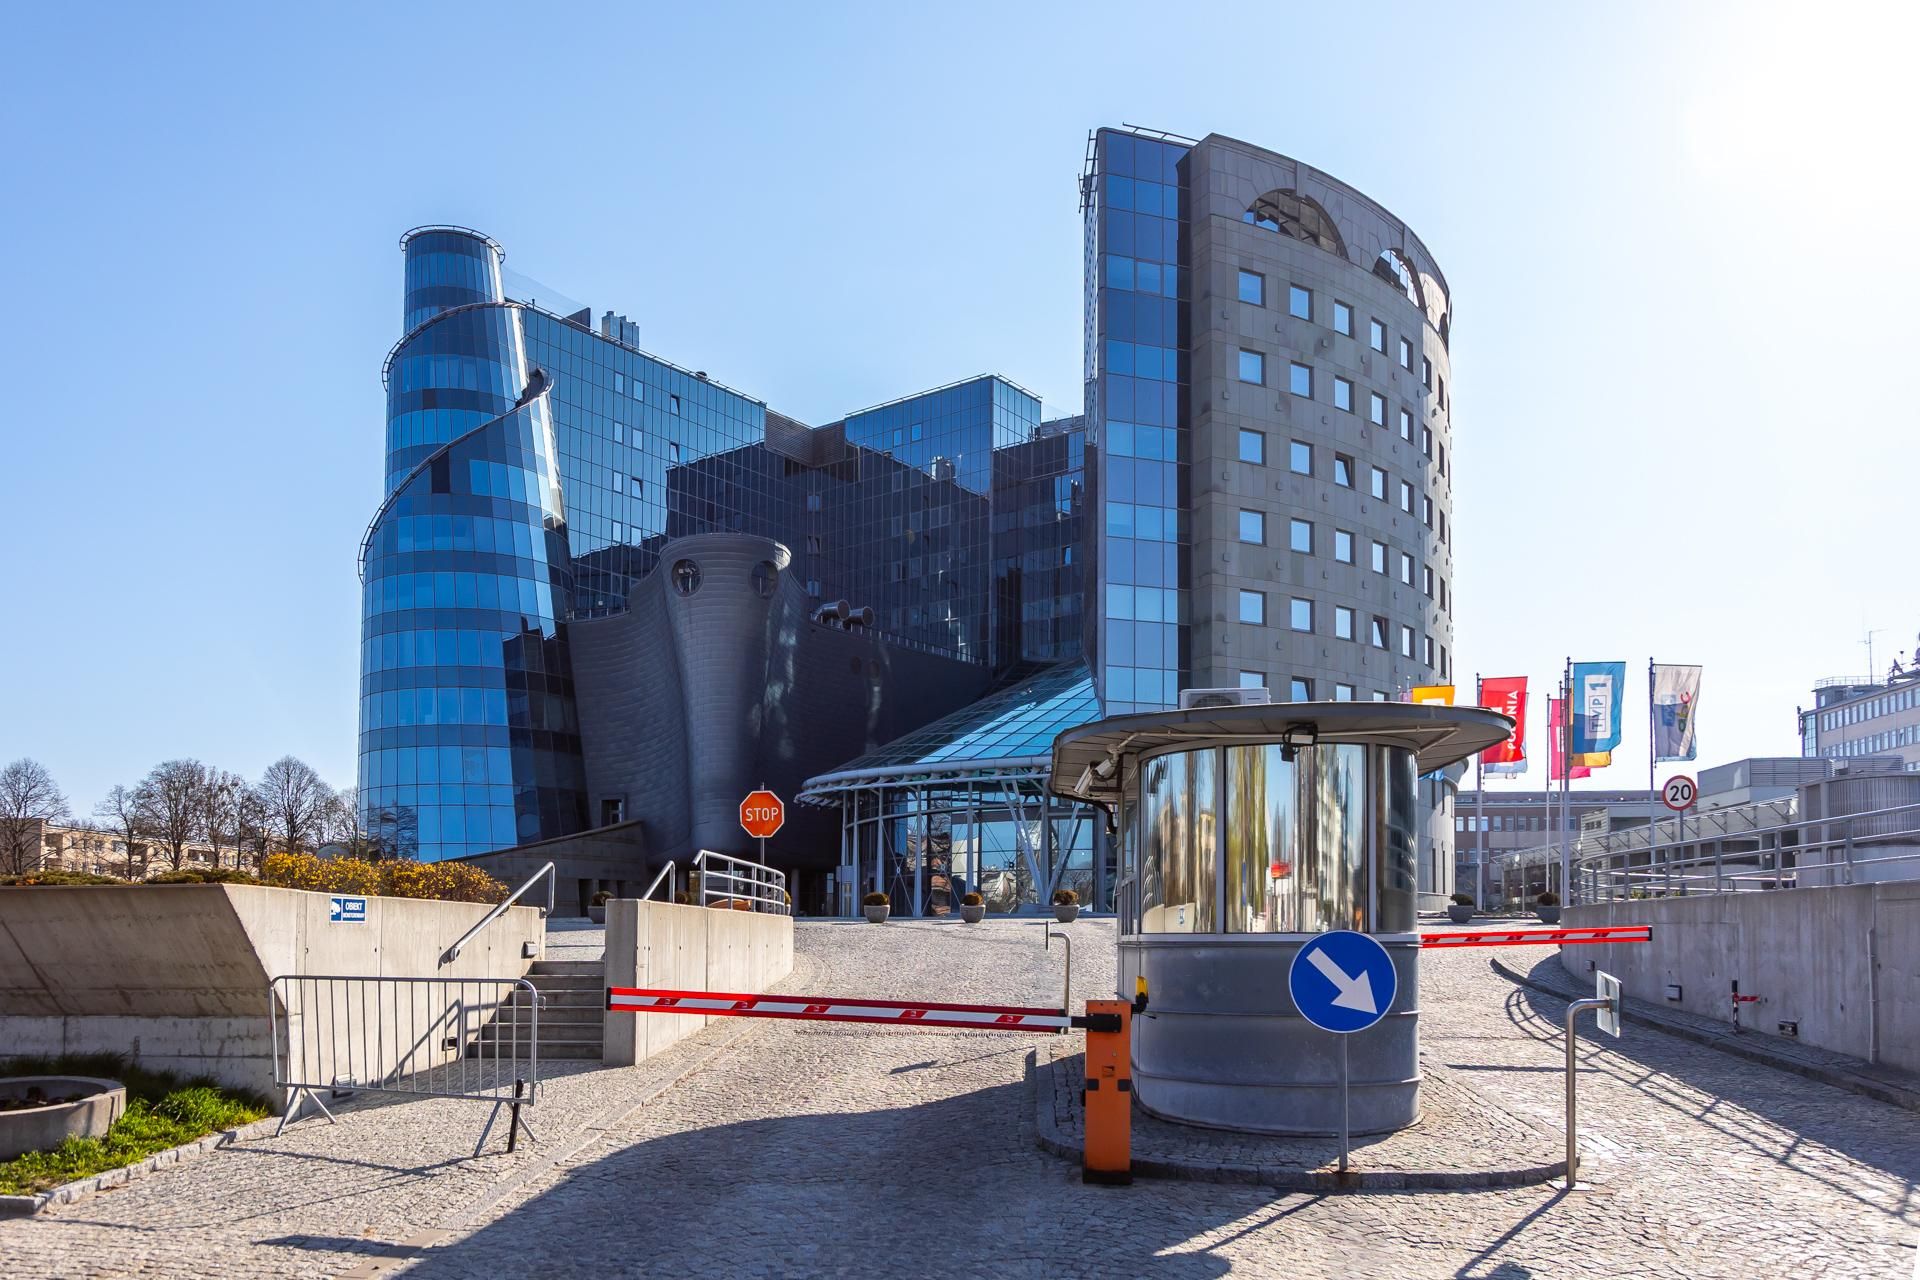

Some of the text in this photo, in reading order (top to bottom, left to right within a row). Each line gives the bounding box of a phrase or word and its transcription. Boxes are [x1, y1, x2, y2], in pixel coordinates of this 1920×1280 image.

[1589, 682, 1607, 731] TVP 1
[1670, 784, 1691, 801] 20
[745, 807, 779, 822] STOP
